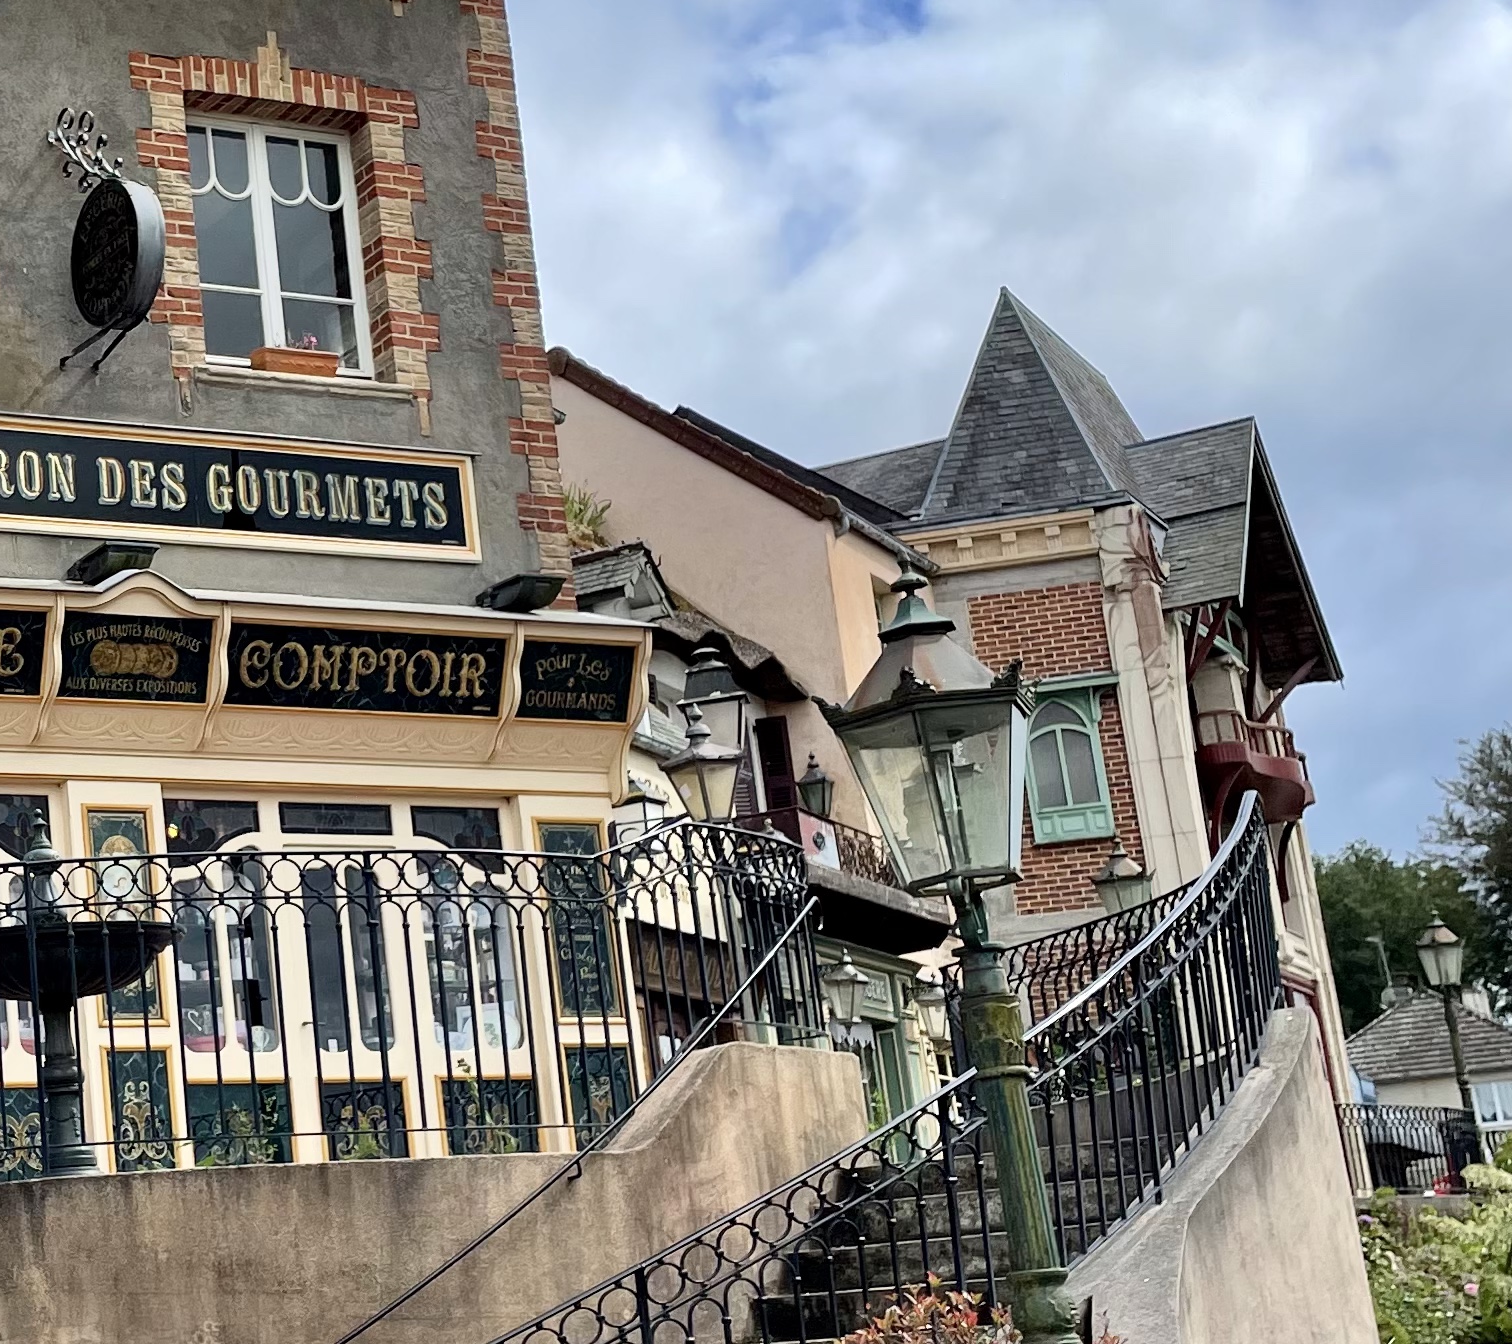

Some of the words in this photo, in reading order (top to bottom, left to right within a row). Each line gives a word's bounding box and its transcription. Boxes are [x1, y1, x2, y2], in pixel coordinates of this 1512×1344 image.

[96, 457, 187, 511] DES
[207, 463, 449, 531] GOURMETS
[69, 631, 85, 647] LES
[86, 625, 108, 642] PLUS
[109, 623, 142, 637] HAUTES
[240, 638, 488, 699] COMPTOIR
[65, 677, 86, 691] AUX
[89, 677, 134, 692] DIVERSES
[136, 679, 197, 695] EXPOSITIONS
[525, 689, 617, 711] GOURMANDS
